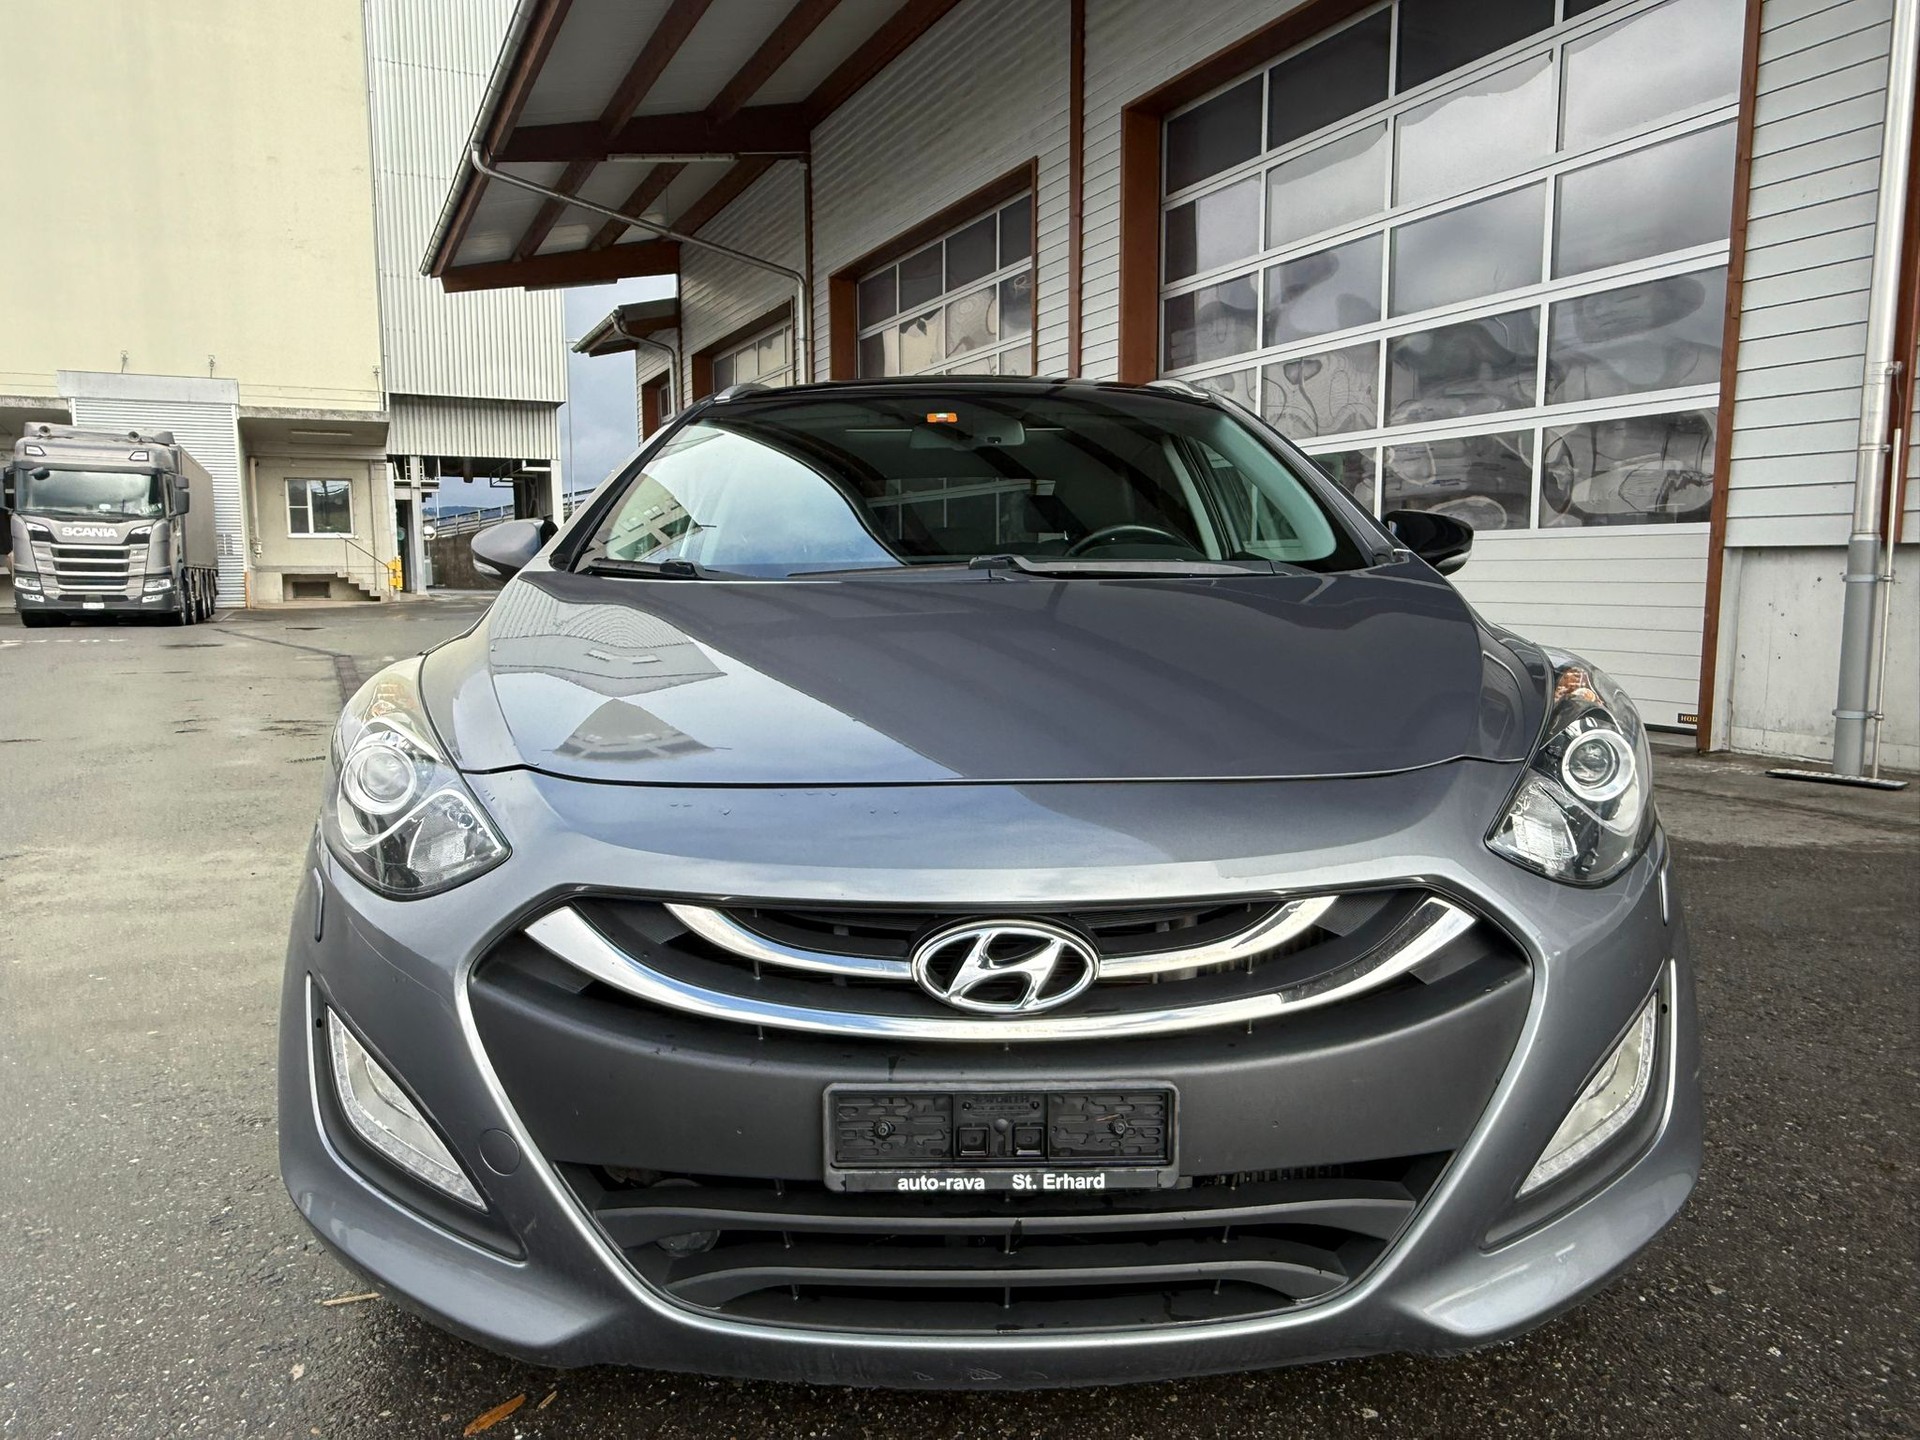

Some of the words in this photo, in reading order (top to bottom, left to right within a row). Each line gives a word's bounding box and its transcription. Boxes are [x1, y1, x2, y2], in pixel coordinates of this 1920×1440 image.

[61, 526, 118, 538] SCANIA
[897, 1174, 985, 1191] auto-rava
[1012, 1173, 1037, 1190] St.
[1042, 1172, 1105, 1190] Erhard
